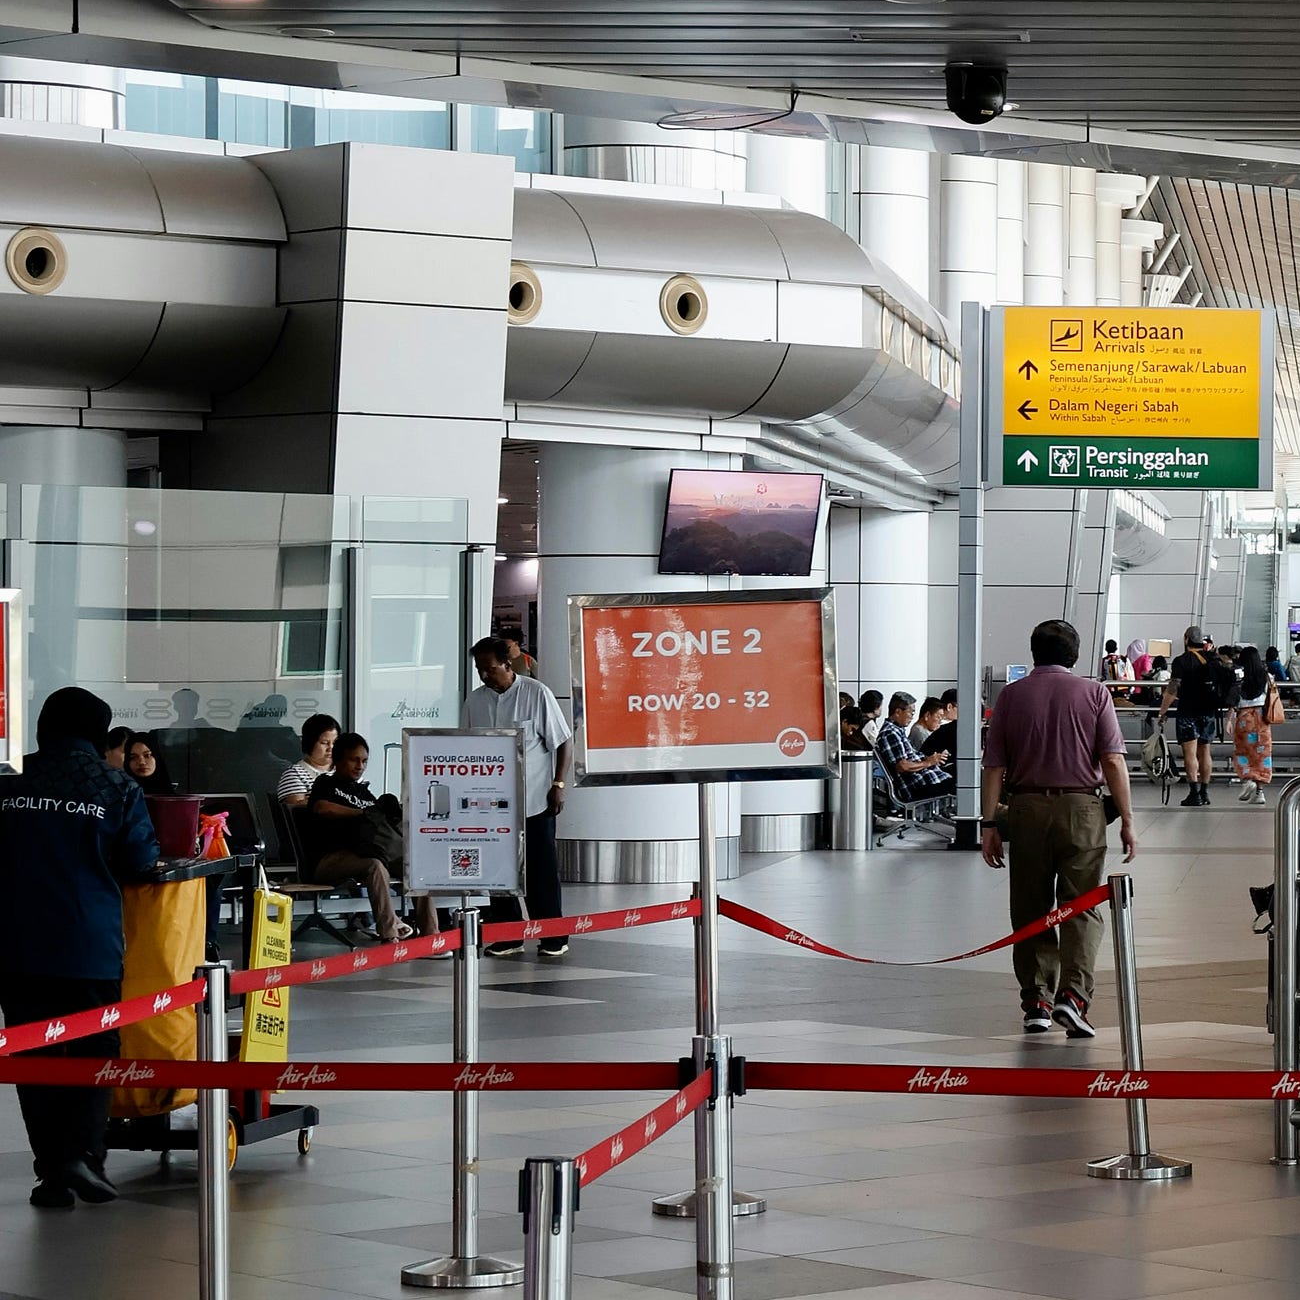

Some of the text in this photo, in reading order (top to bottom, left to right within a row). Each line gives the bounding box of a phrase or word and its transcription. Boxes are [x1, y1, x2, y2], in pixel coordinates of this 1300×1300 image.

[1093, 320, 1184, 340] Ketibaan
[1094, 341, 1145, 353] Arrivals
[1049, 399, 1179, 415] Dalam Negeri Sabah
[1050, 413, 1079, 422] Within
[1082, 414, 1107, 422] Sabah
[1086, 446, 1209, 471] Persinggahan
[1086, 465, 1129, 478] Transit
[632, 628, 762, 658] ZONE 2
[627, 692, 686, 713] ROW
[691, 691, 721, 710] 20
[743, 690, 770, 708] 32
[424, 765, 446, 776] FIT
[448, 765, 469, 776] TO
[2, 796, 106, 819] FACILITY CARE
[266, 935, 286, 950] CLEANING
[267, 948, 287, 963] PROGRESS
